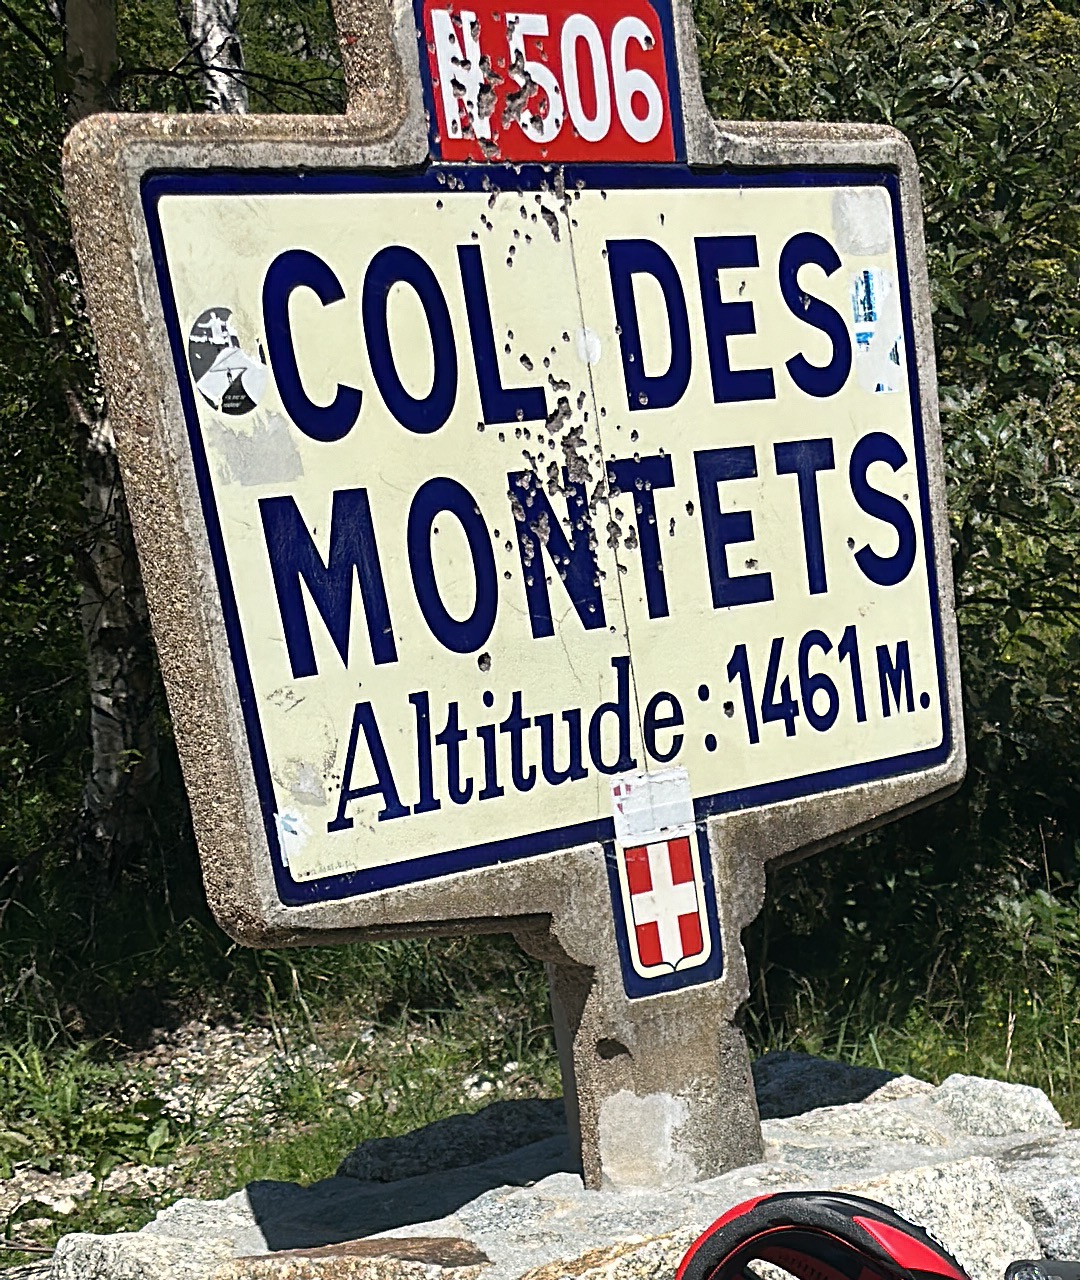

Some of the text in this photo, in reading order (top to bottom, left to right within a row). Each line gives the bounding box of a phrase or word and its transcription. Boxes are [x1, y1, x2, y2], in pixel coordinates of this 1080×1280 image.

[504, 13, 664, 144] 506
[262, 231, 854, 443] COL DES
[258, 431, 918, 681] MONTETS
[726, 625, 868, 745] 1461
